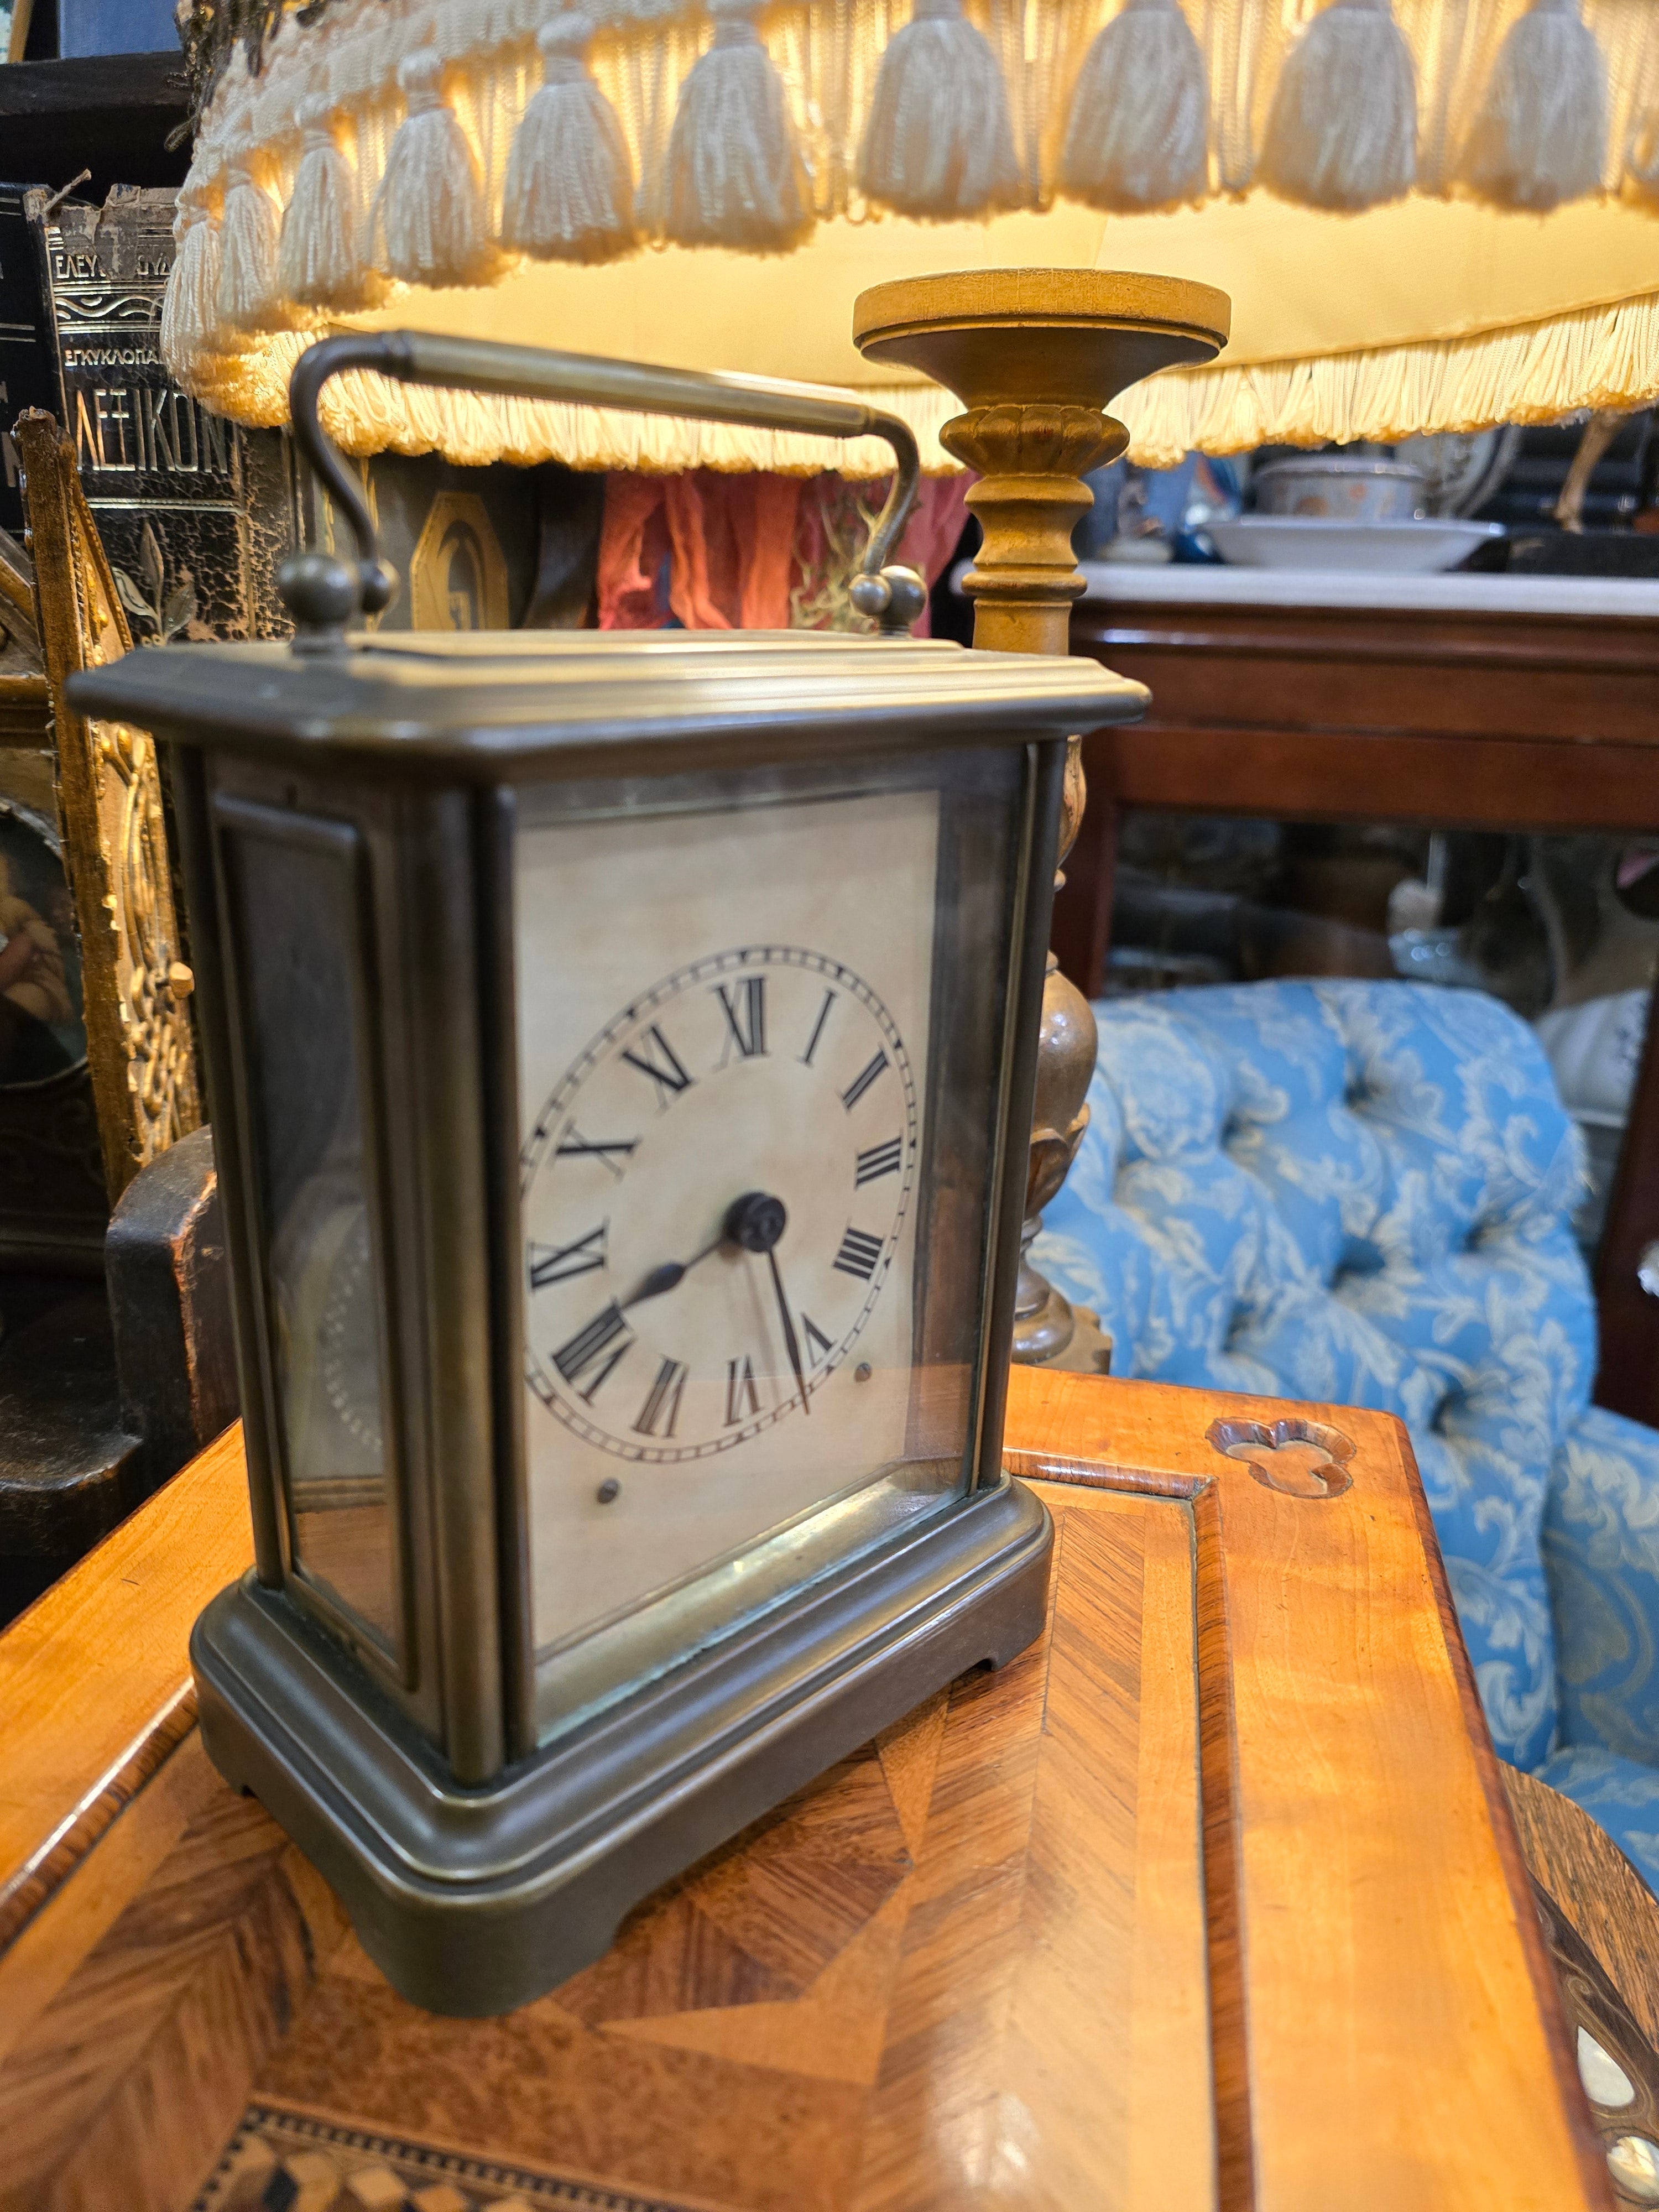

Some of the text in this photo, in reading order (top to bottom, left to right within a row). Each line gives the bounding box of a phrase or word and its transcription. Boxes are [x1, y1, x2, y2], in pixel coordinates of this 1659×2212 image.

[64, 348, 165, 366] ΕΓΚΥΚΛΟΠΑ
[711, 975, 768, 1072] XII
[797, 987, 838, 1067] I
[619, 1023, 698, 1117] XI
[837, 1043, 889, 1113] II
[550, 1119, 642, 1183] X
[855, 1129, 903, 1190] III
[527, 1219, 609, 1294] IX
[832, 1219, 885, 1282] IIII
[550, 1295, 637, 1408] VIII
[801, 1312, 837, 1369] V
[630, 1355, 689, 1439] VII
[723, 1355, 764, 1427] VI
